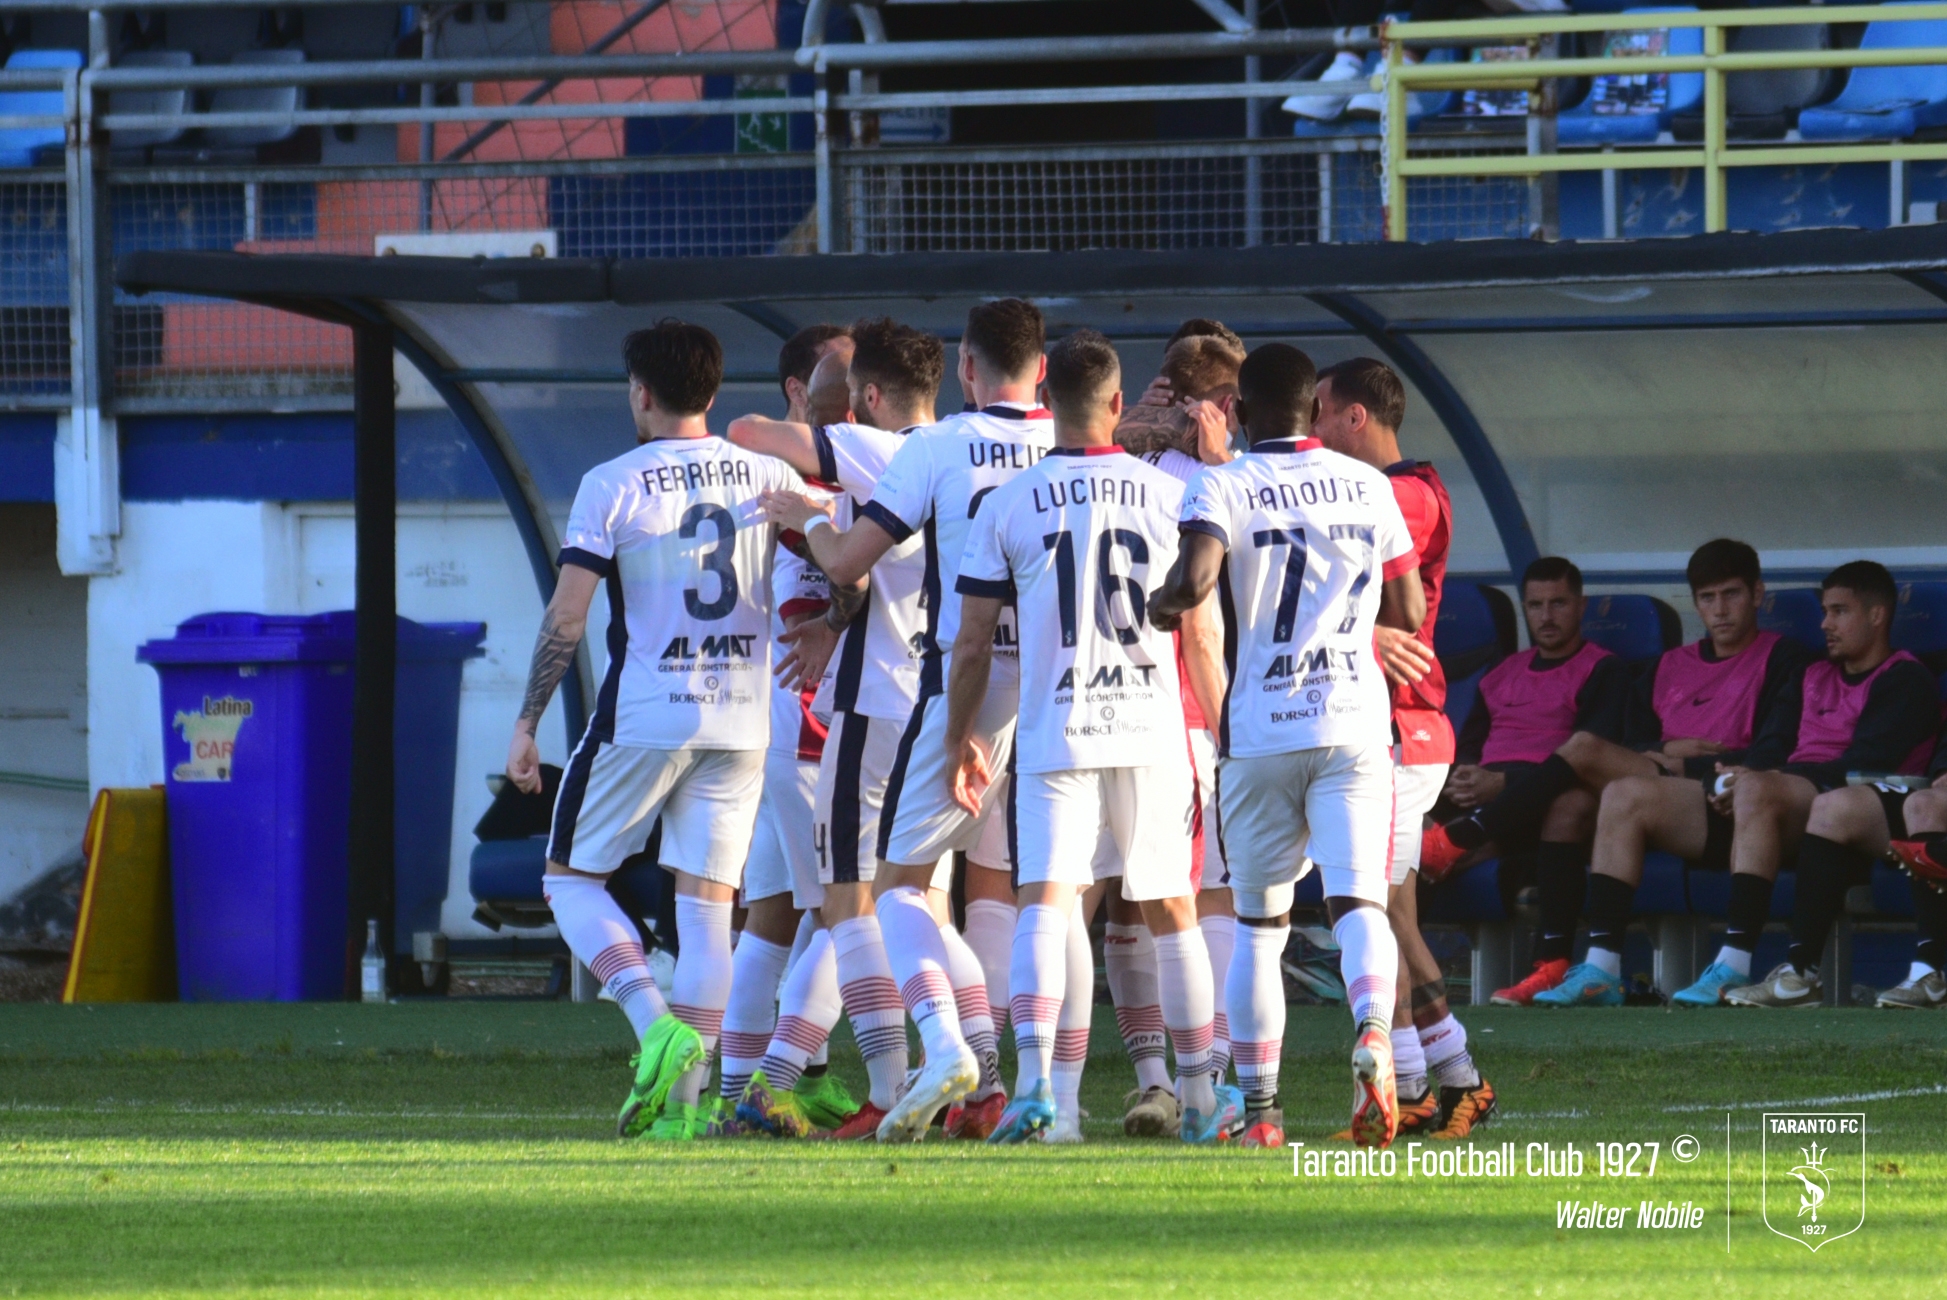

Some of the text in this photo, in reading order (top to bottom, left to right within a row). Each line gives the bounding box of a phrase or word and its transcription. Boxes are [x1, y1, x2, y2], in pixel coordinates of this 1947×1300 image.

[641, 460, 751, 496] FERRARA
[1032, 477, 1146, 514] LUCIANI
[679, 502, 738, 622] 3
[1043, 528, 1149, 648] 16
[1253, 524, 1376, 643] 77
[660, 634, 757, 660] ALMAT
[658, 664, 697, 673] GENERAL
[1055, 664, 1157, 692] AMT
[204, 697, 252, 716] Latina
[669, 692, 715, 704] BORSCI
[1055, 693, 1153, 705] GENEL CONSTRUTION
[1270, 707, 1318, 723] BORSCI
[1065, 725, 1112, 737] BORSCI
[1150, 1034, 1162, 1044] FC
